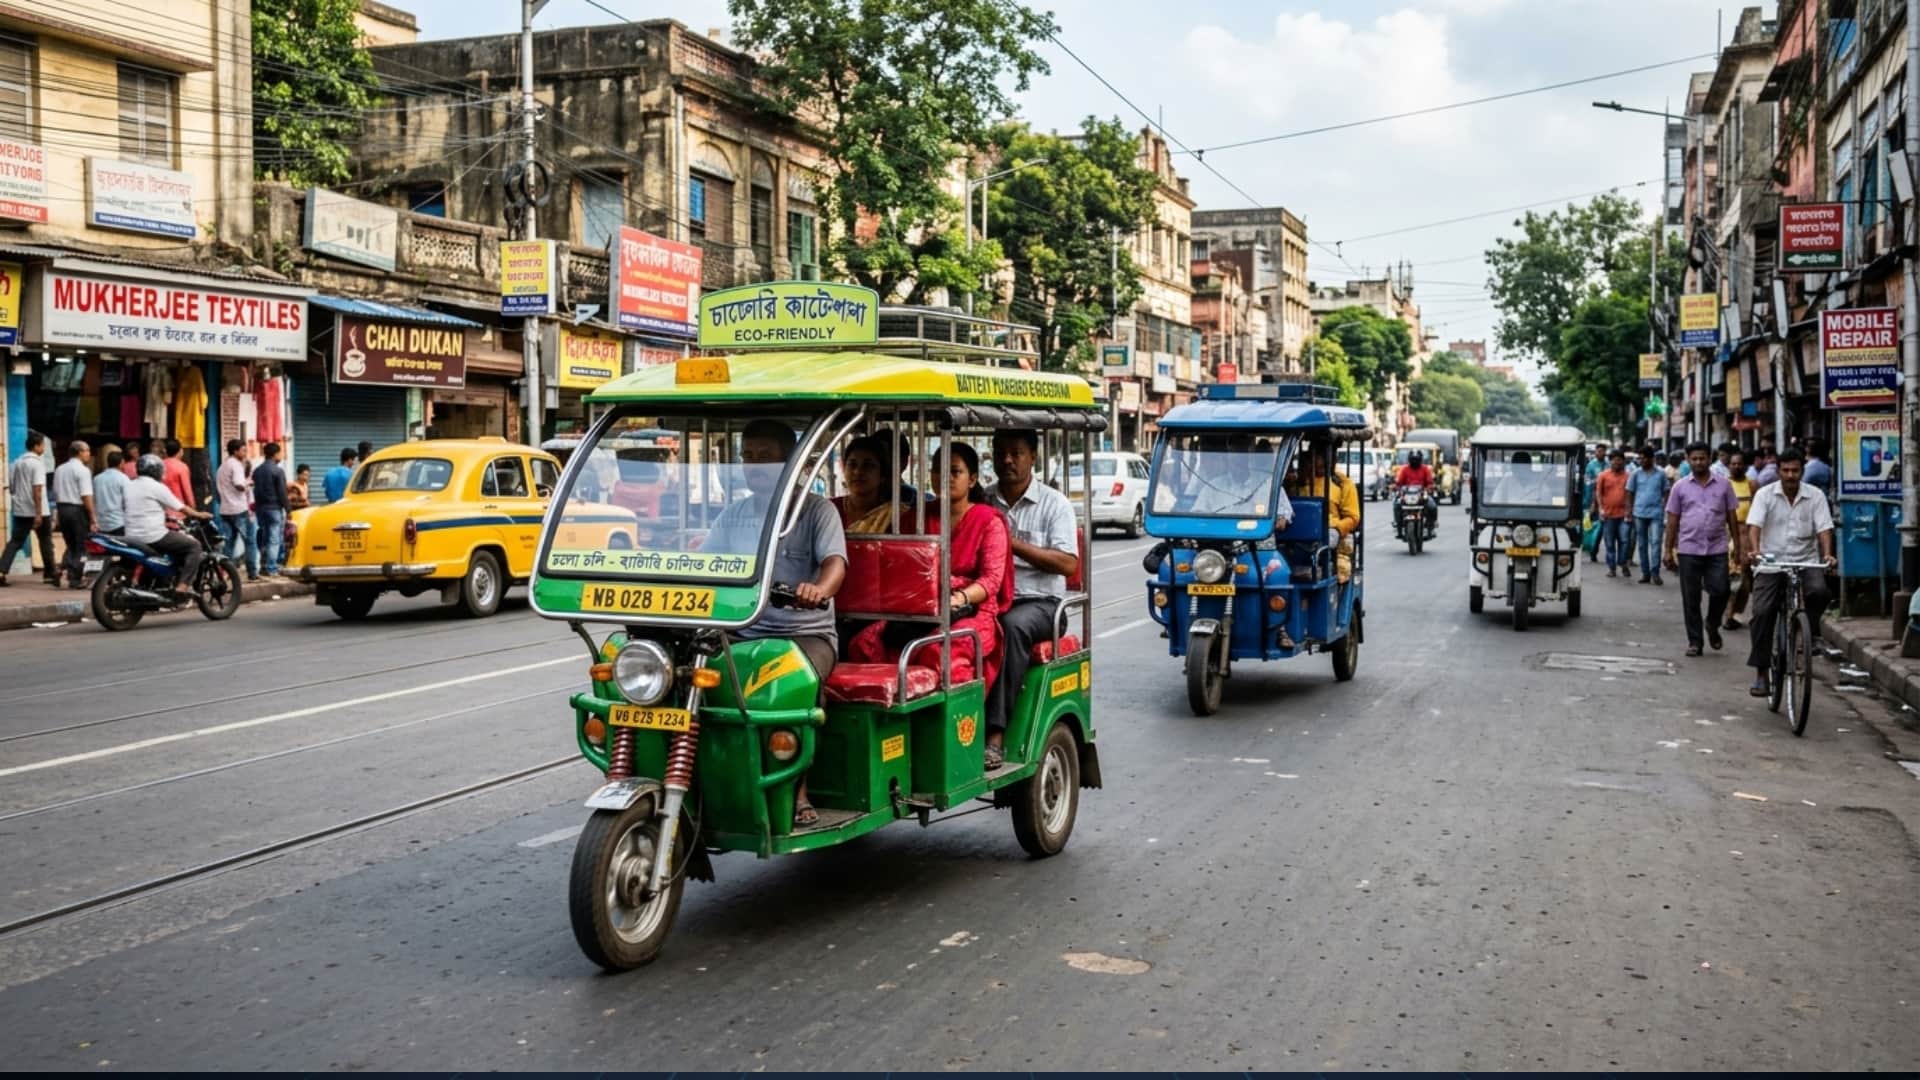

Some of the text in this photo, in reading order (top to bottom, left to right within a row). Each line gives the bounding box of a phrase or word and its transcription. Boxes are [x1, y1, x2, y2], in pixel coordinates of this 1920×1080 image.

[53, 278, 199, 322] MUKHERJEE
[206, 295, 301, 331] TEXTILES
[1826, 313, 1894, 330] MOBILE
[365, 324, 463, 357] CHAI DUKAN
[734, 327, 836, 342] ECO-FRIENDLY
[1829, 330, 1892, 347] REPAIR
[661, 591, 710, 612] 1234
[657, 712, 685, 727] 1234
